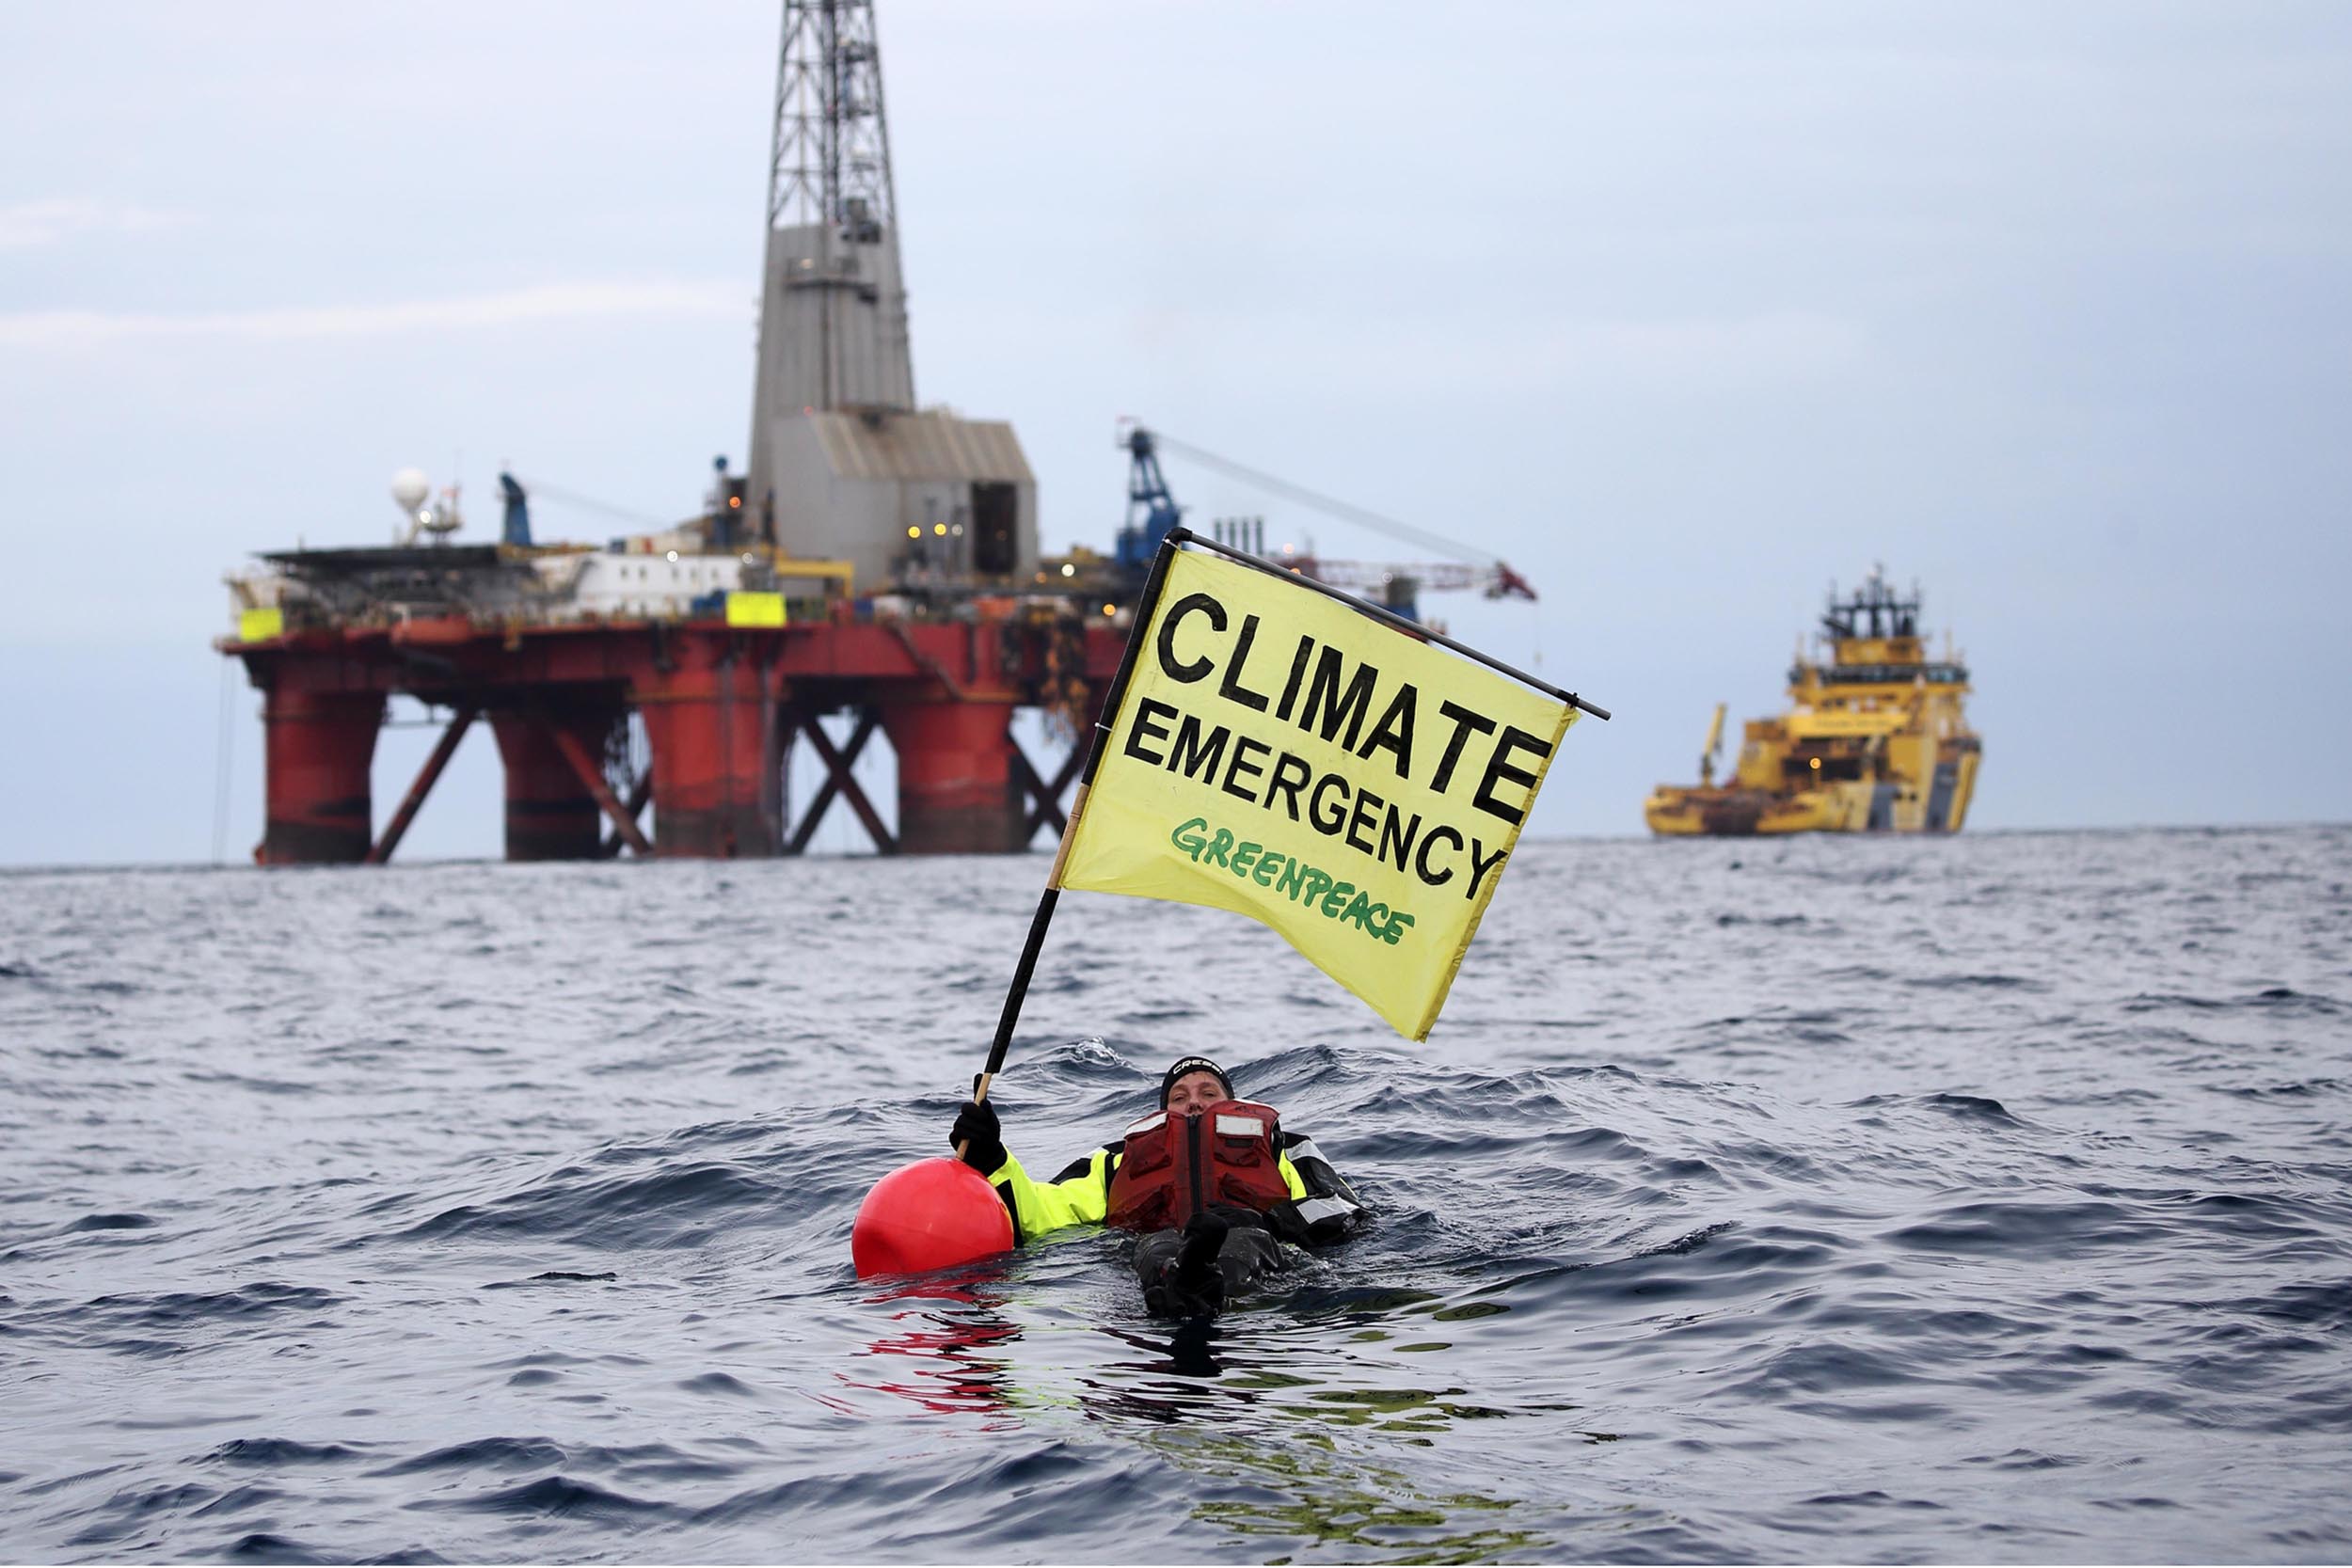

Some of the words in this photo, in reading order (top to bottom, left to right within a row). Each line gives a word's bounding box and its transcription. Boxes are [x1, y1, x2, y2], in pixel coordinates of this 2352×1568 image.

[1124, 697, 1507, 900] EMERGENCY
[1157, 594, 1552, 825] CLIMATE
[1171, 817, 1415, 945] GREENPEACE
